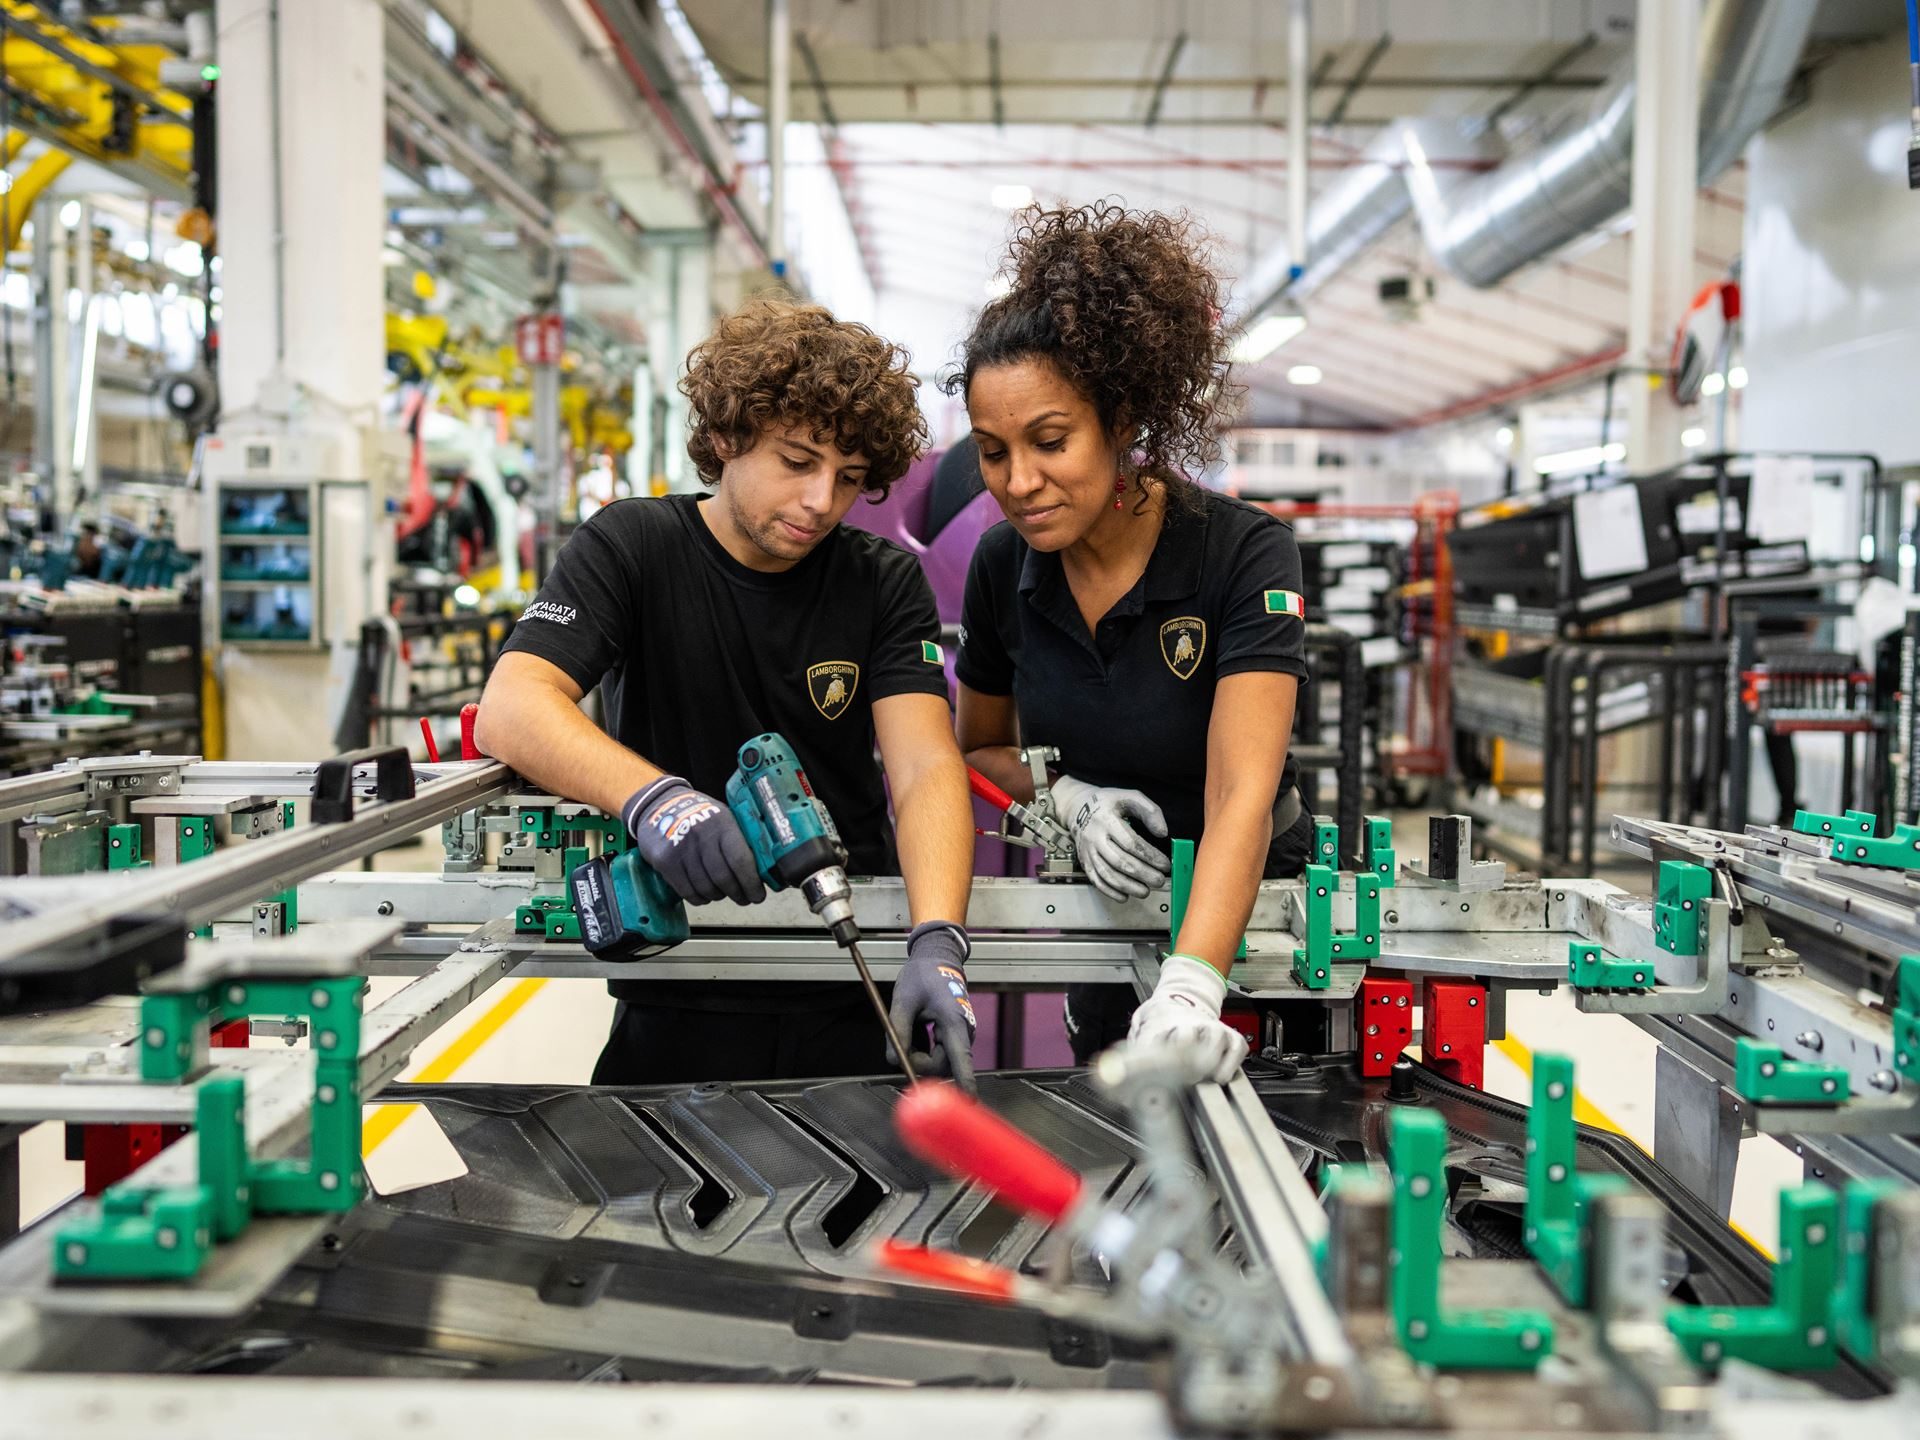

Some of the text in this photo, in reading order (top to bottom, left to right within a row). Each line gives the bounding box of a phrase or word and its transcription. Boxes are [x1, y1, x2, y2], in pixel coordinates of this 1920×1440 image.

[517, 609, 571, 624] OGNESE
[811, 665, 855, 678] LAMBORGHINI
[668, 805, 720, 847] uvex
